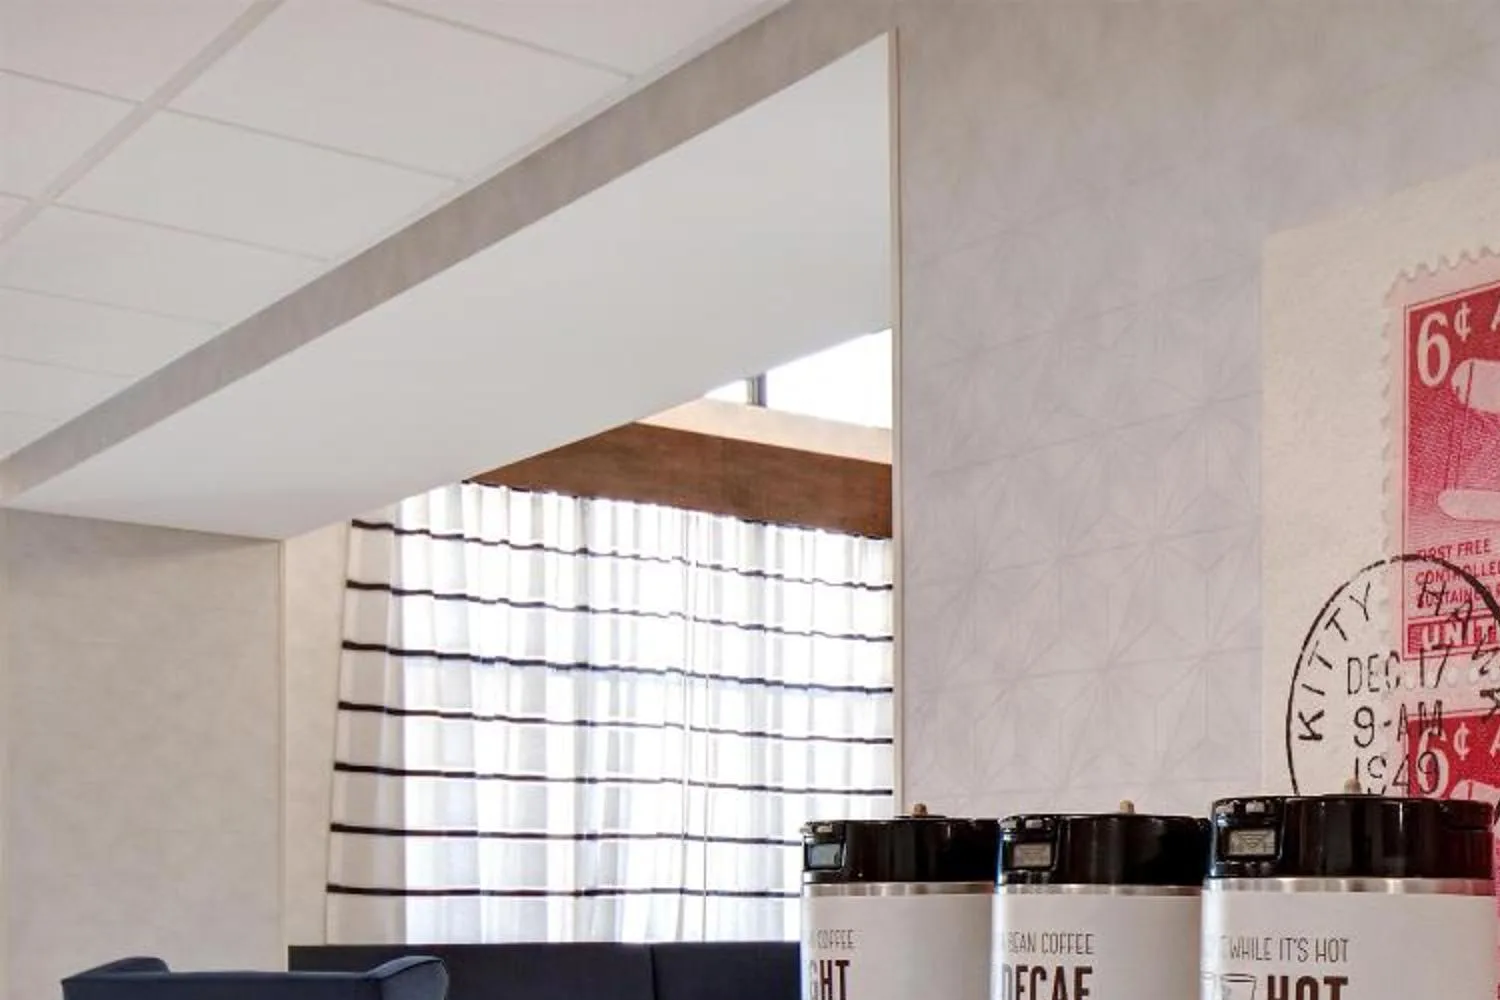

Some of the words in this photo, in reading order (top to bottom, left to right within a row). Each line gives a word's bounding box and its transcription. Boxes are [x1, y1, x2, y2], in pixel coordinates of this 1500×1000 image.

[1458, 539, 1491, 556] FREE
[1298, 582, 1371, 741] KITTY
[1347, 650, 1401, 695] DEC
[1041, 932, 1095, 955] COFFEE
[1229, 936, 1273, 961] WHILE
[1279, 937, 1309, 963] IT'S
[1315, 938, 1349, 963] HOT
